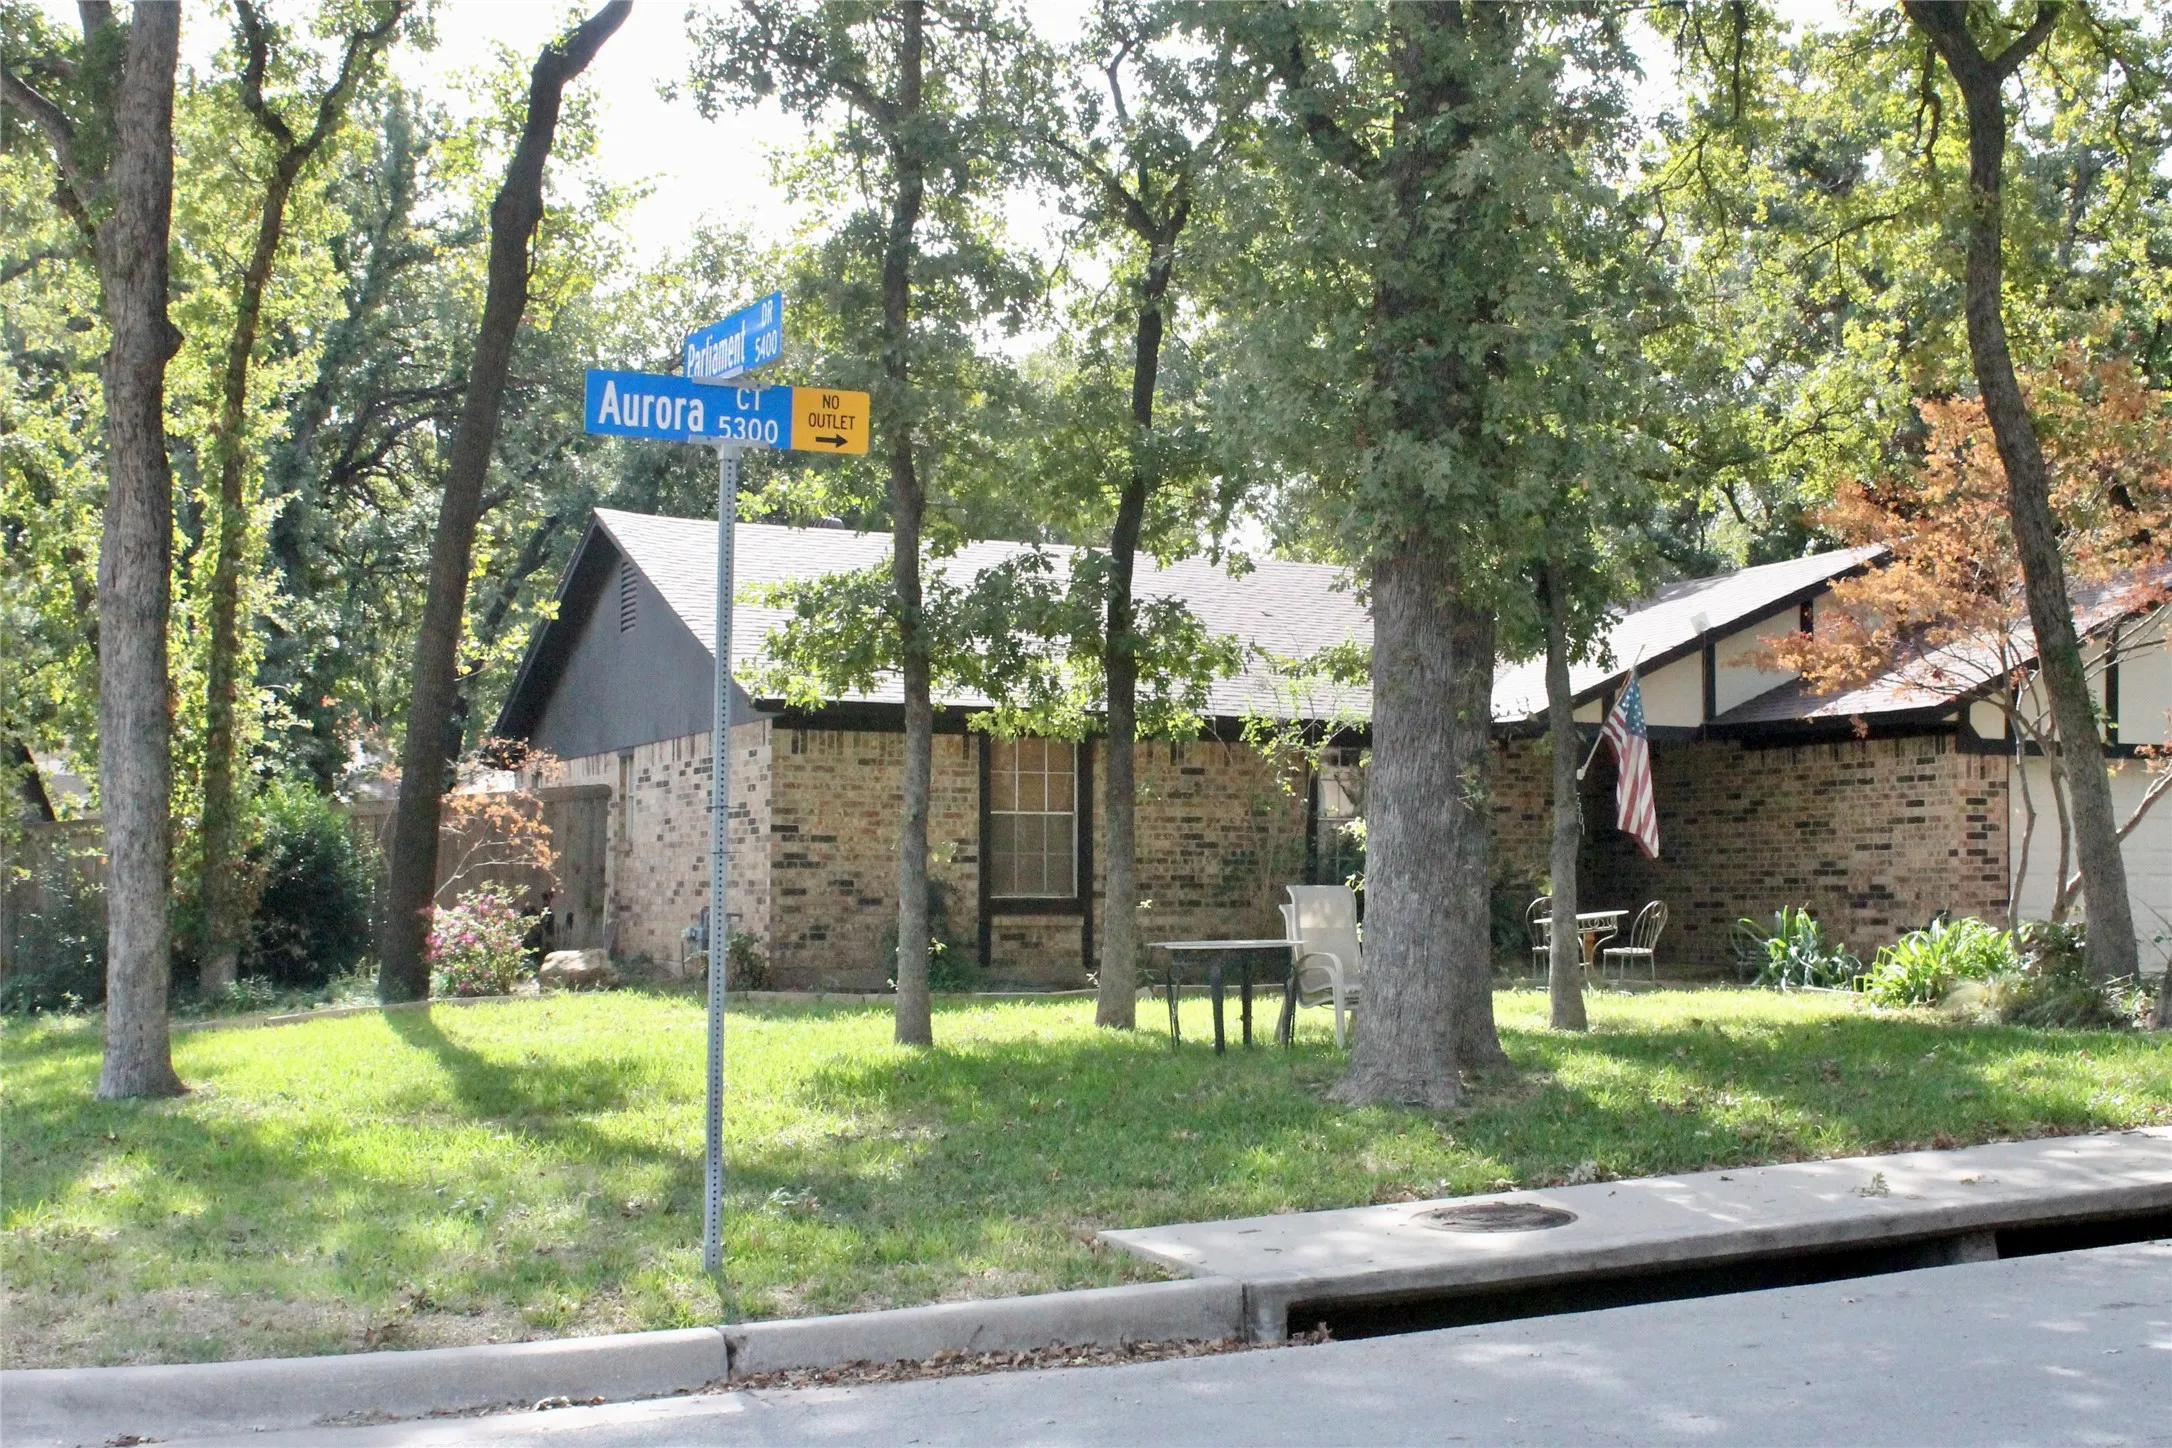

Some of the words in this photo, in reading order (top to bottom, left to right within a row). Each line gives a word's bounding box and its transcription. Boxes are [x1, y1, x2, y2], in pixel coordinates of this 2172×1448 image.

[760, 299, 773, 328] DR
[687, 320, 746, 377] Parliament
[755, 329, 778, 362] 5400
[598, 381, 704, 432] Aurora
[736, 389, 763, 411] CT
[822, 394, 840, 410] NO
[718, 416, 779, 444] 5300
[808, 412, 856, 430] OUTLET
